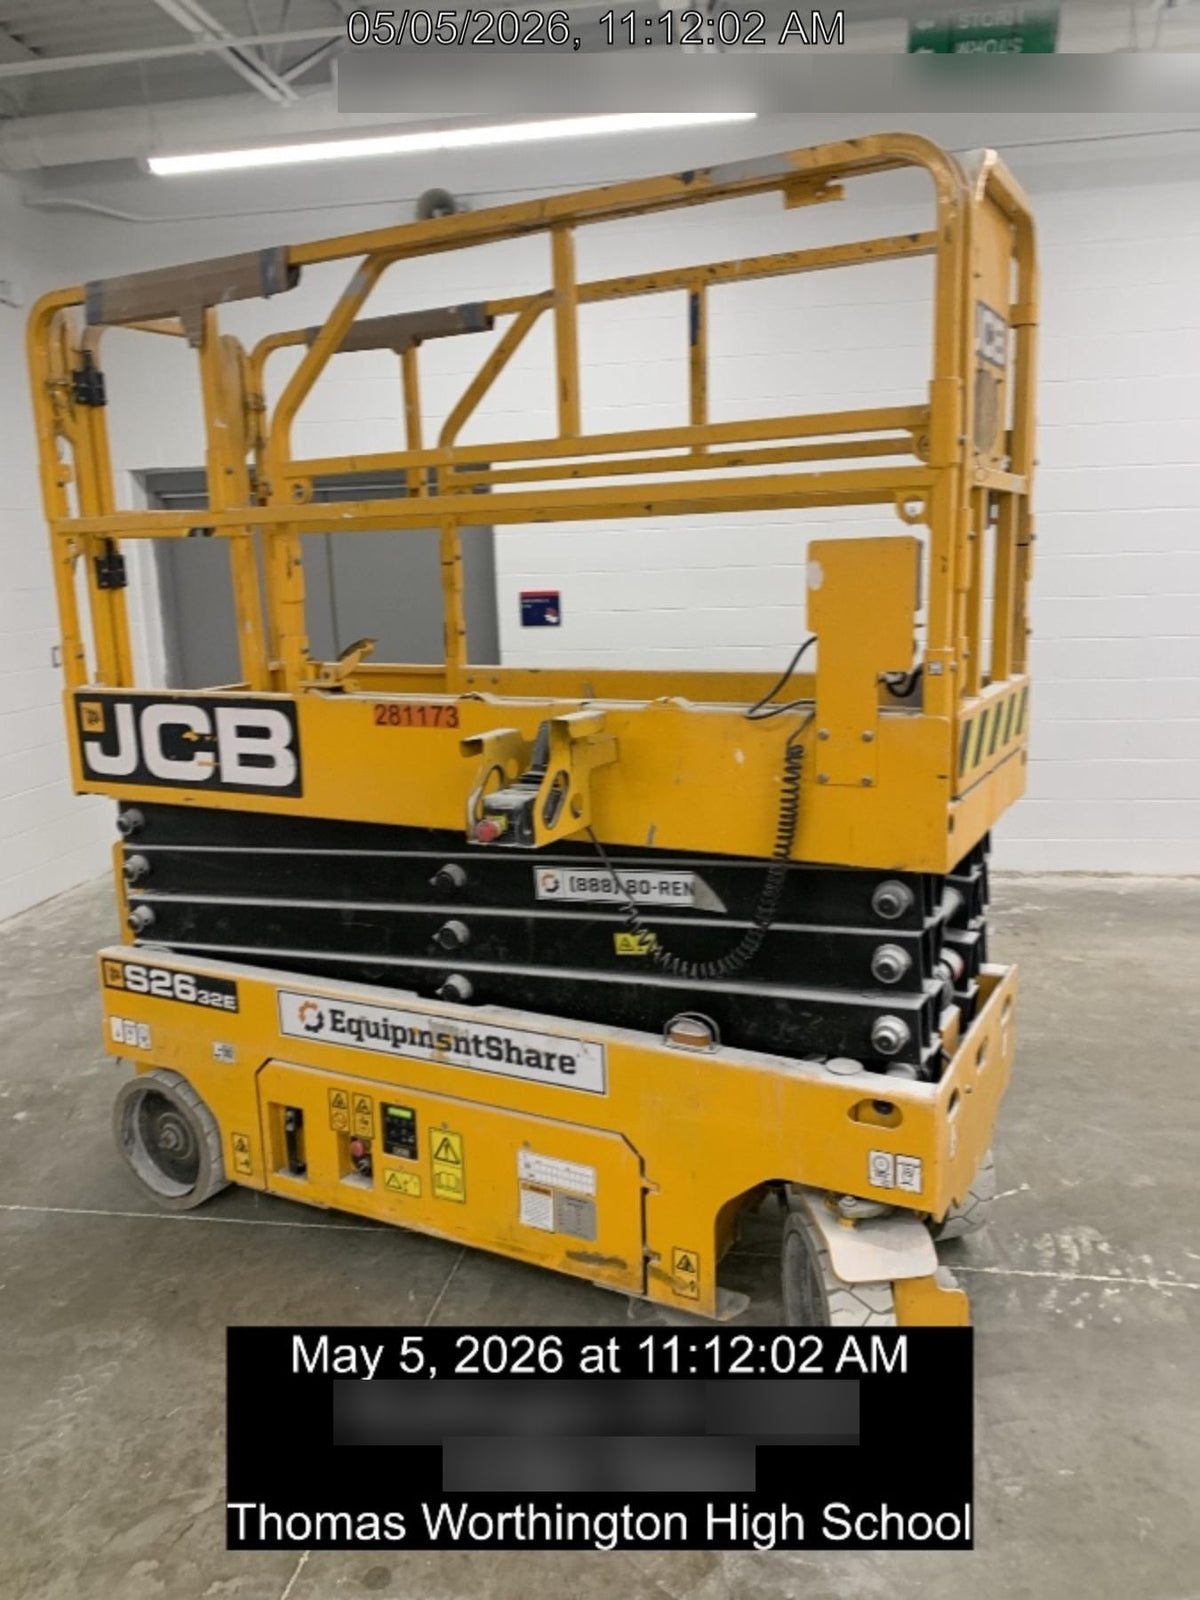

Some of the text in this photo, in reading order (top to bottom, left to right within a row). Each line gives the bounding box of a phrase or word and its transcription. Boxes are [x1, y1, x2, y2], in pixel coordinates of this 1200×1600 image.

[374, 703, 459, 728] 281173
[84, 703, 298, 787] JCB
[569, 876, 619, 895] (888)
